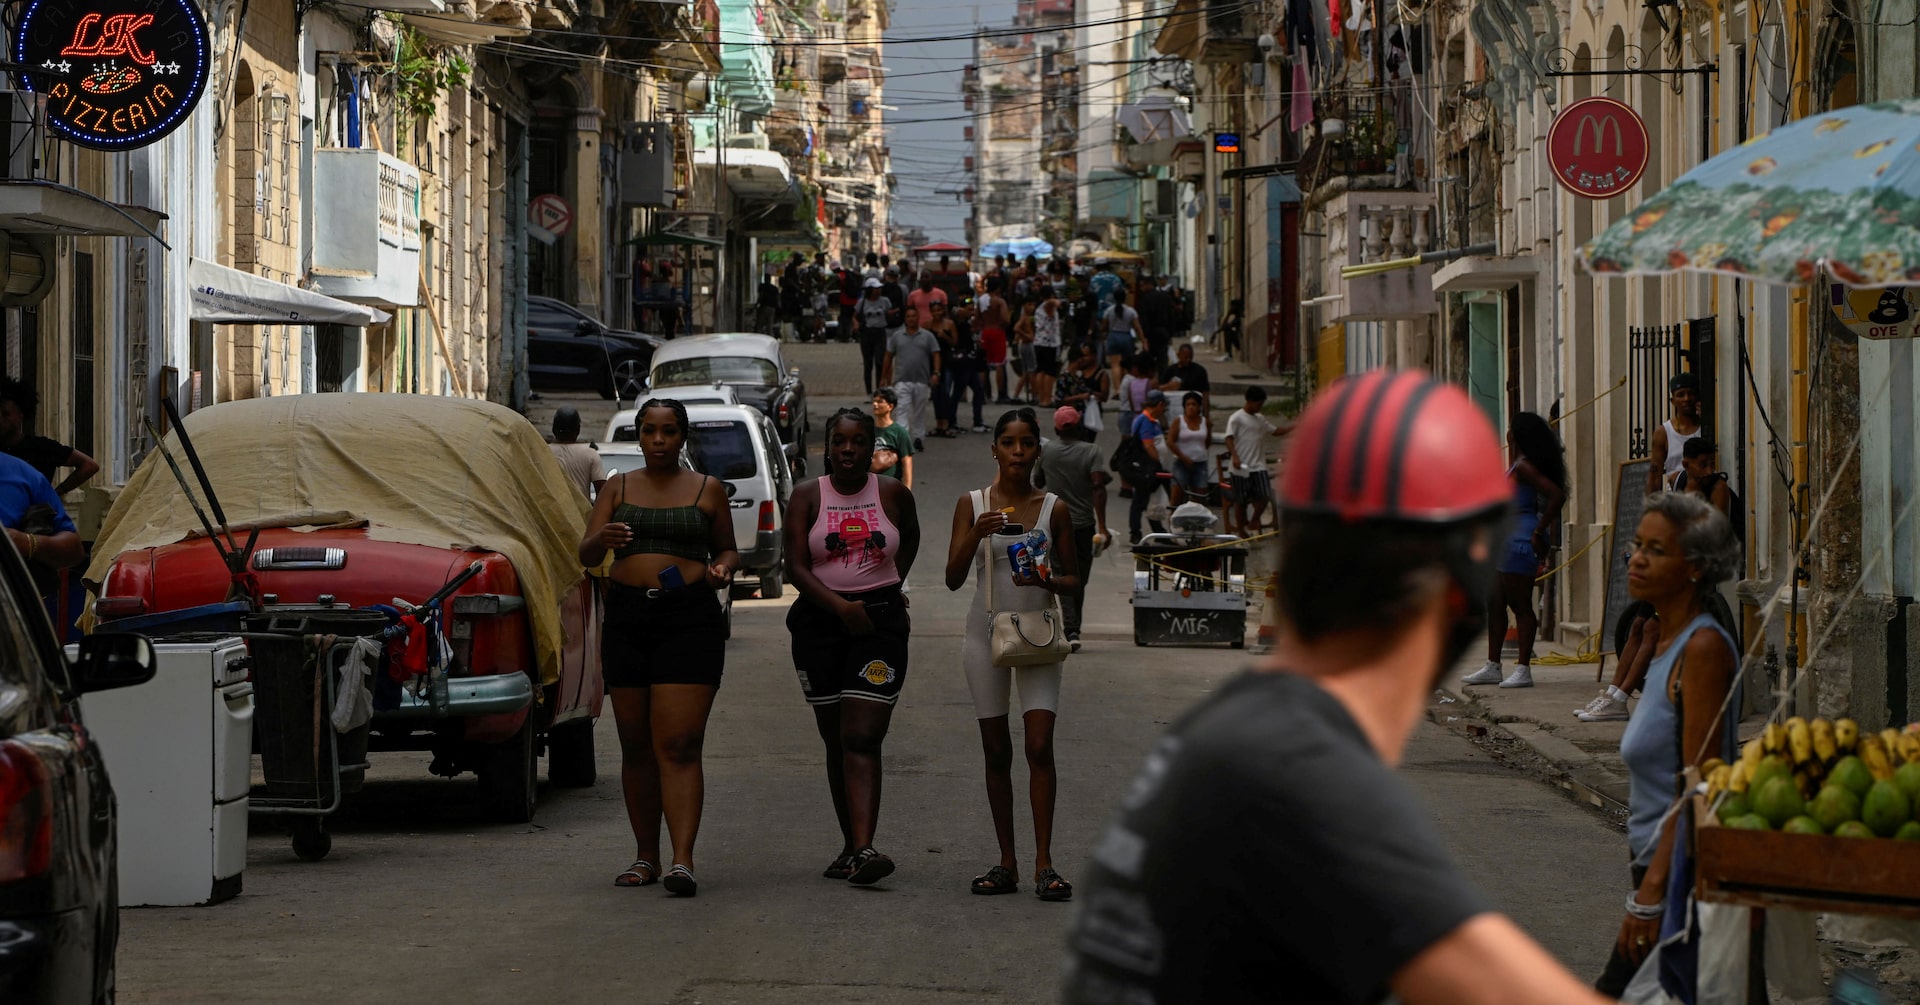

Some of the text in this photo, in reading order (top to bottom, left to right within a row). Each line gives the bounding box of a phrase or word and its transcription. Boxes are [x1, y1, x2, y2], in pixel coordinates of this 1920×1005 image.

[61, 13, 155, 65] LK
[48, 83, 174, 132] PIZZERIA
[1573, 114, 1623, 156] M
[1870, 326, 1898, 337] OYE
